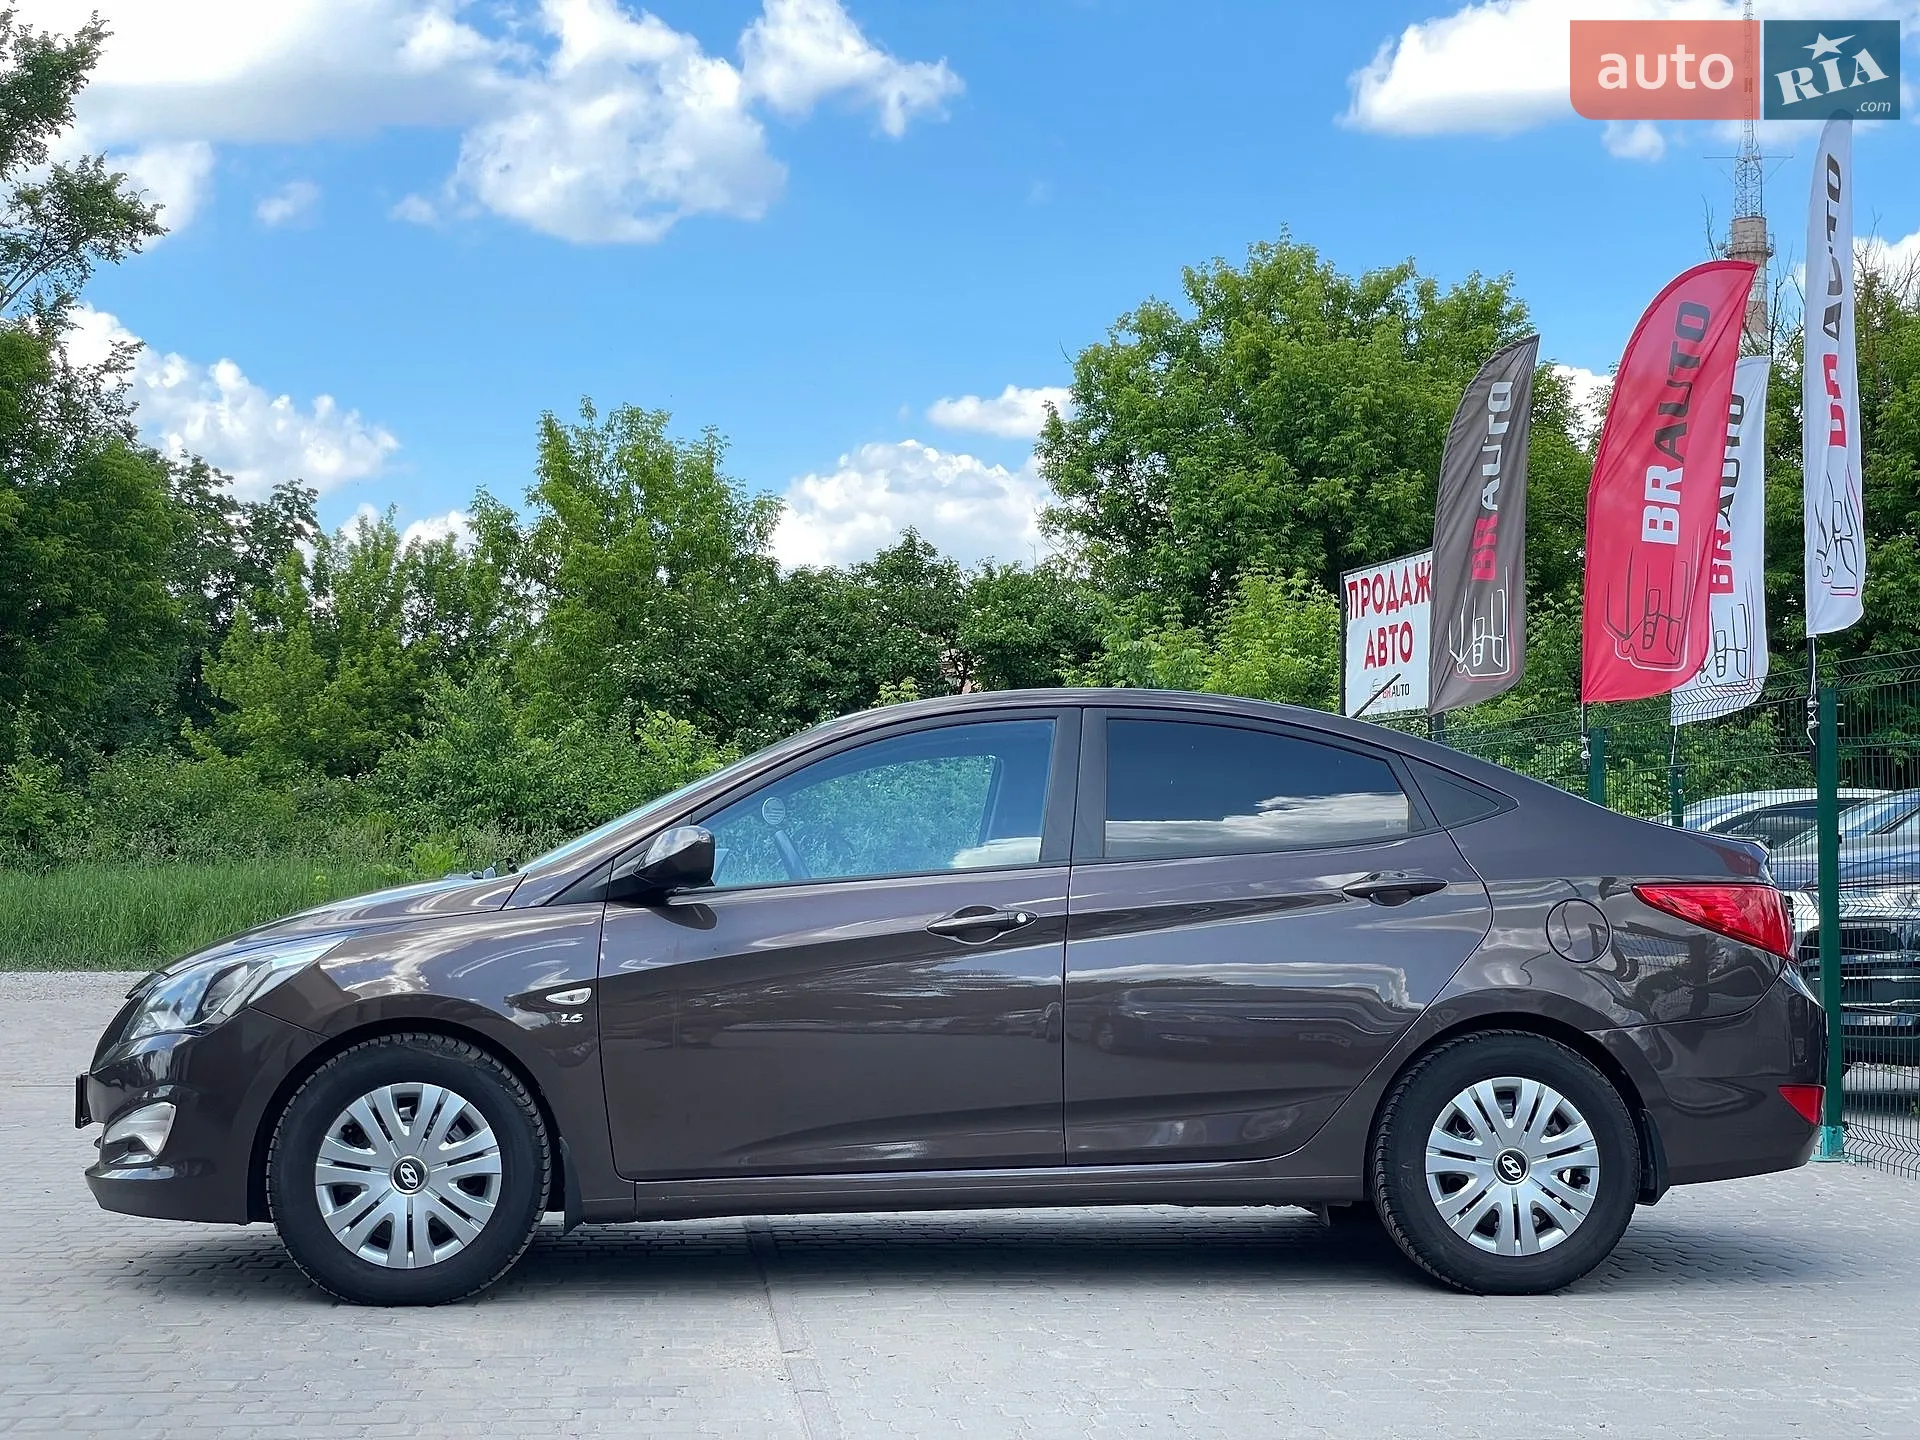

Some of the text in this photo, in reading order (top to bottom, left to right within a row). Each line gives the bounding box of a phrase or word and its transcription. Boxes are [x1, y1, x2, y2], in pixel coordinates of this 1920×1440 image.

[1471, 381, 1513, 581] BRAUTO
[1641, 301, 1711, 545] BRAUTO
[1348, 560, 1432, 620] ПРОДАЖ
[1364, 621, 1414, 670] АВТО
